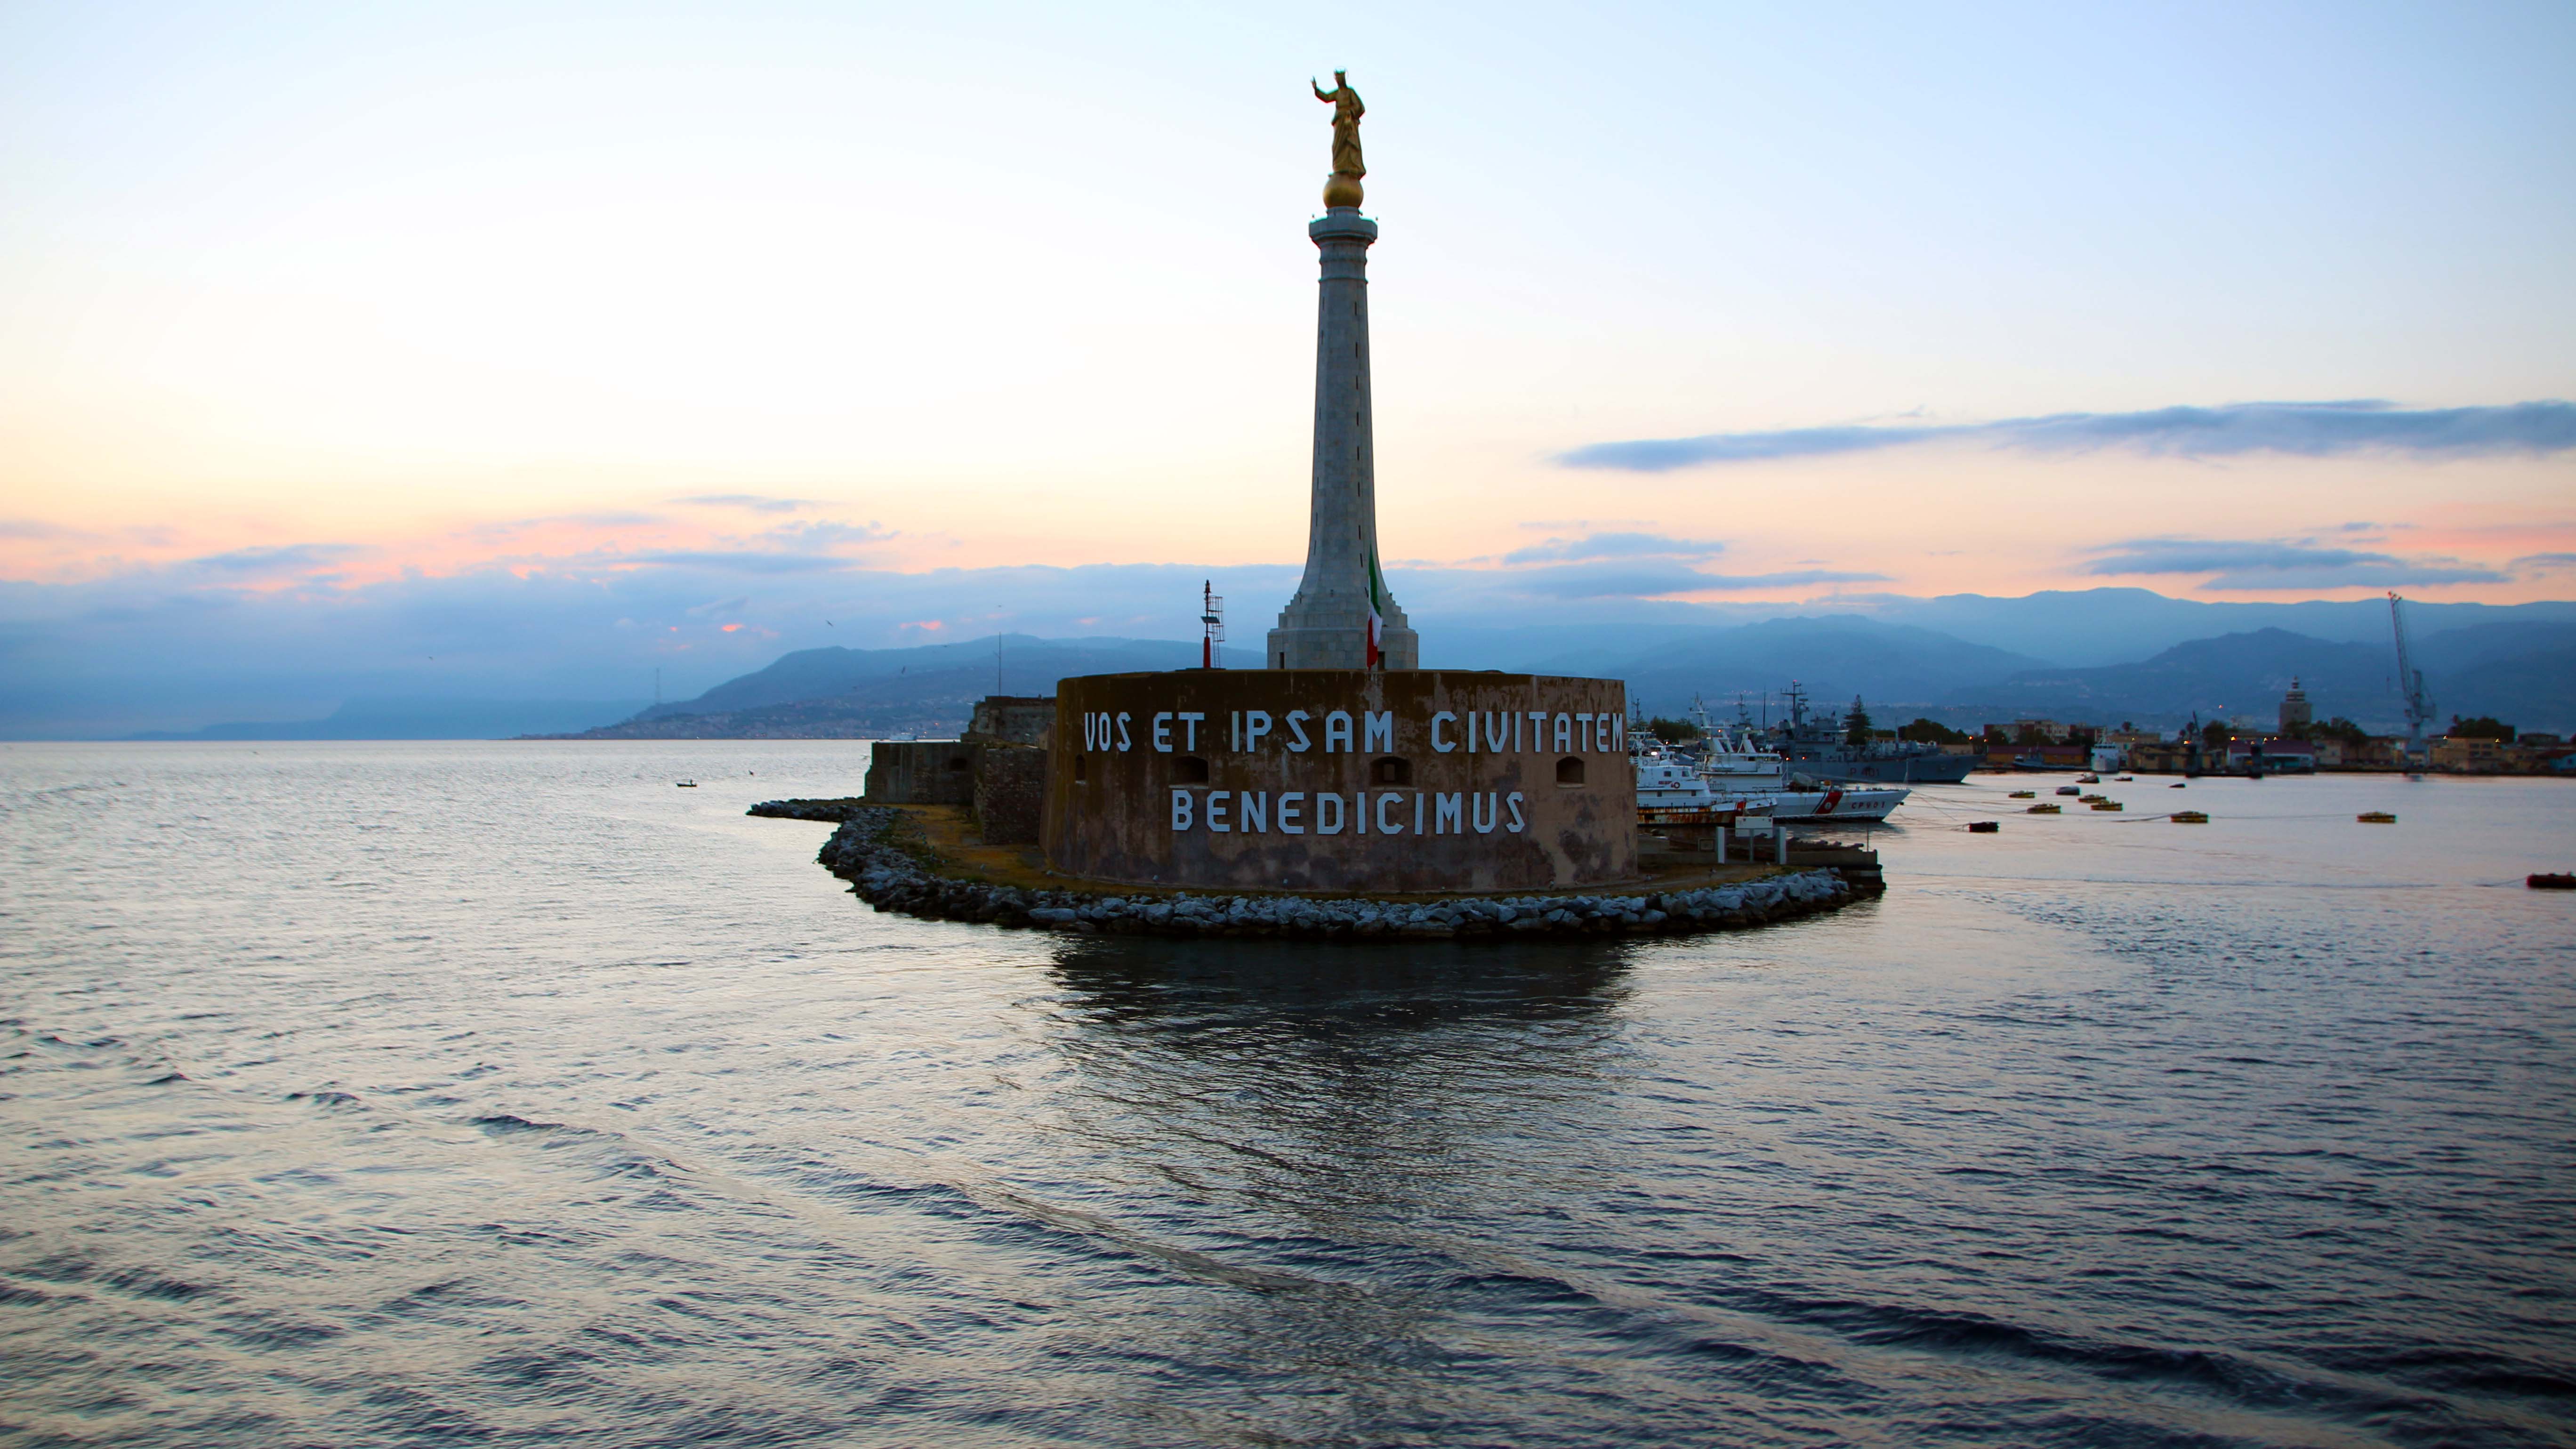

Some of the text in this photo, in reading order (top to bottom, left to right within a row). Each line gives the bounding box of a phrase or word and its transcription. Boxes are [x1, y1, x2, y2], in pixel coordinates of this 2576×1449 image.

[1085, 710, 1623, 753] VOS ET IPSAM CIVITATEM
[1172, 790, 1525, 835] BENEDICIMUS
